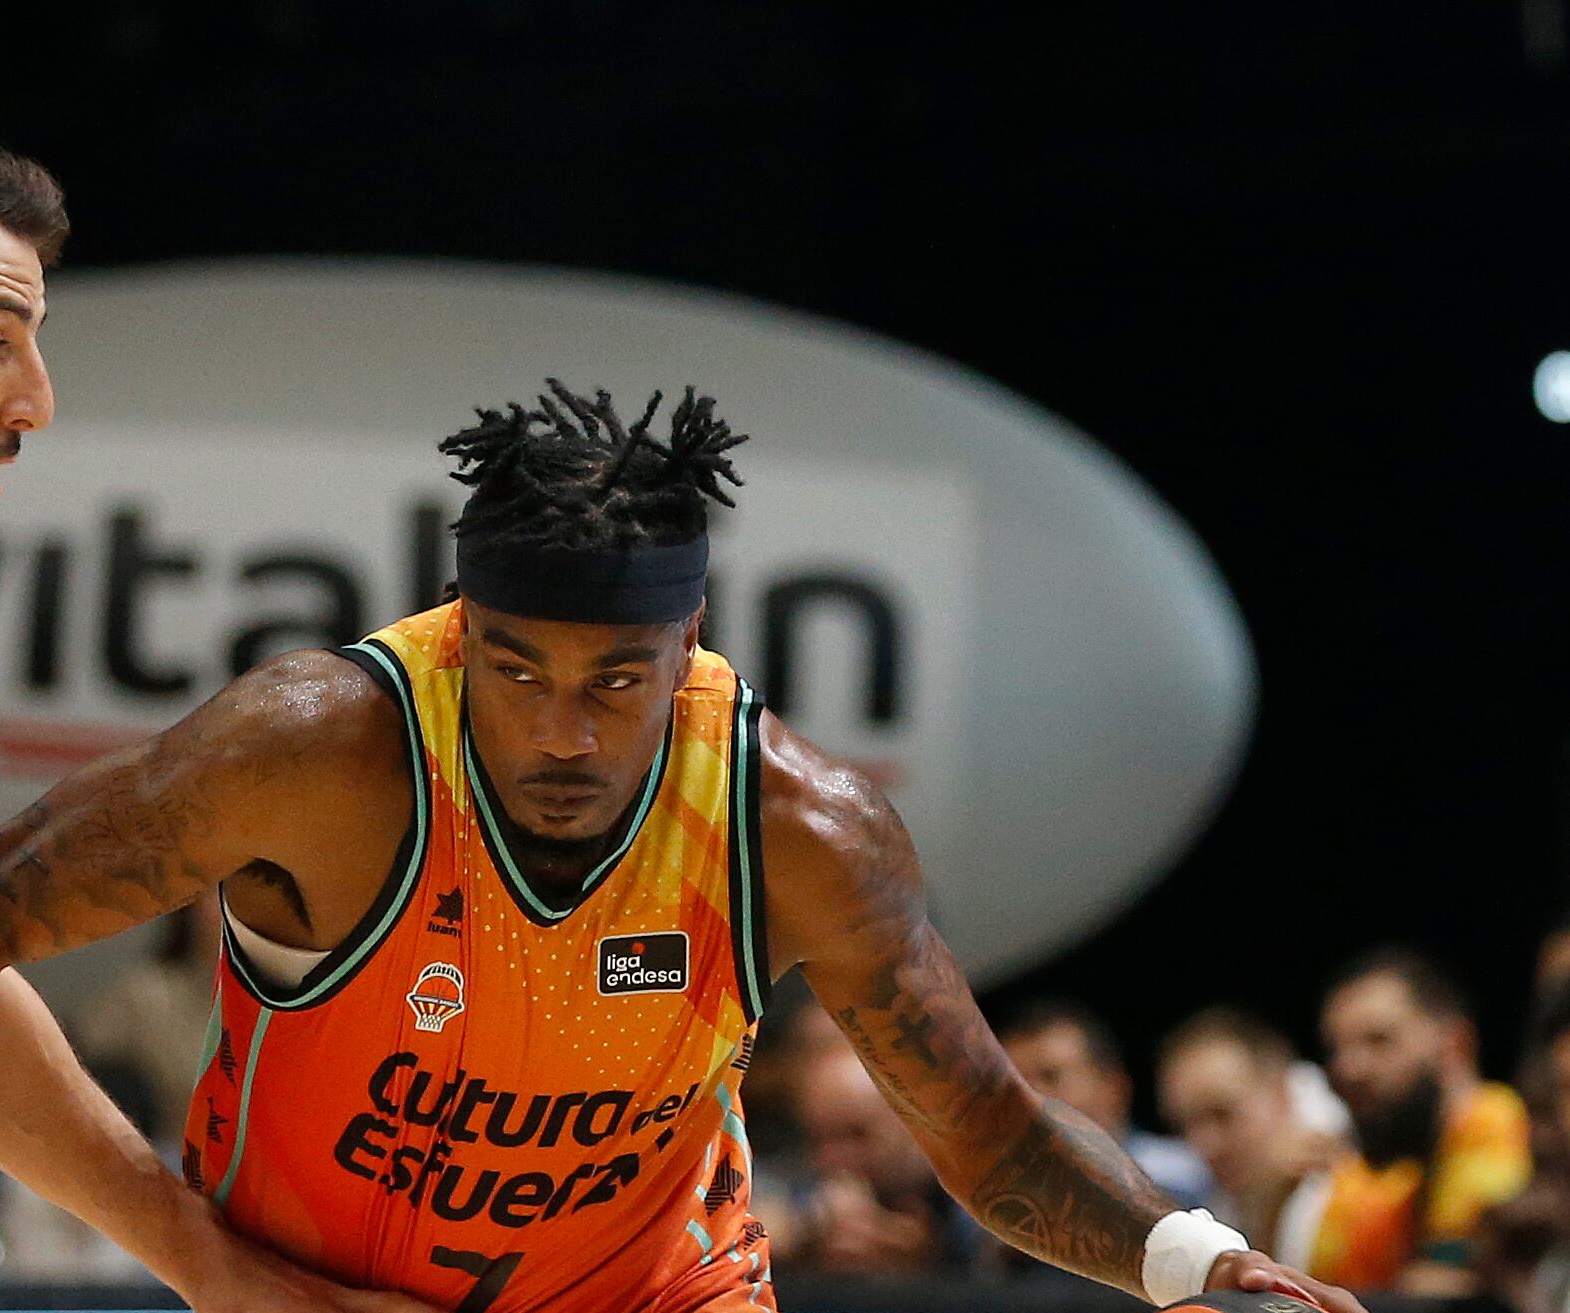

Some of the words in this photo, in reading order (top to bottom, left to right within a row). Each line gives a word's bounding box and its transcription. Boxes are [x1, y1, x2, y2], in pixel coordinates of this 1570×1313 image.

[606, 953, 641, 973] liga
[606, 968, 682, 988] endesa
[368, 1051, 636, 1148] Cultura
[334, 1112, 675, 1228] Esfuerz
